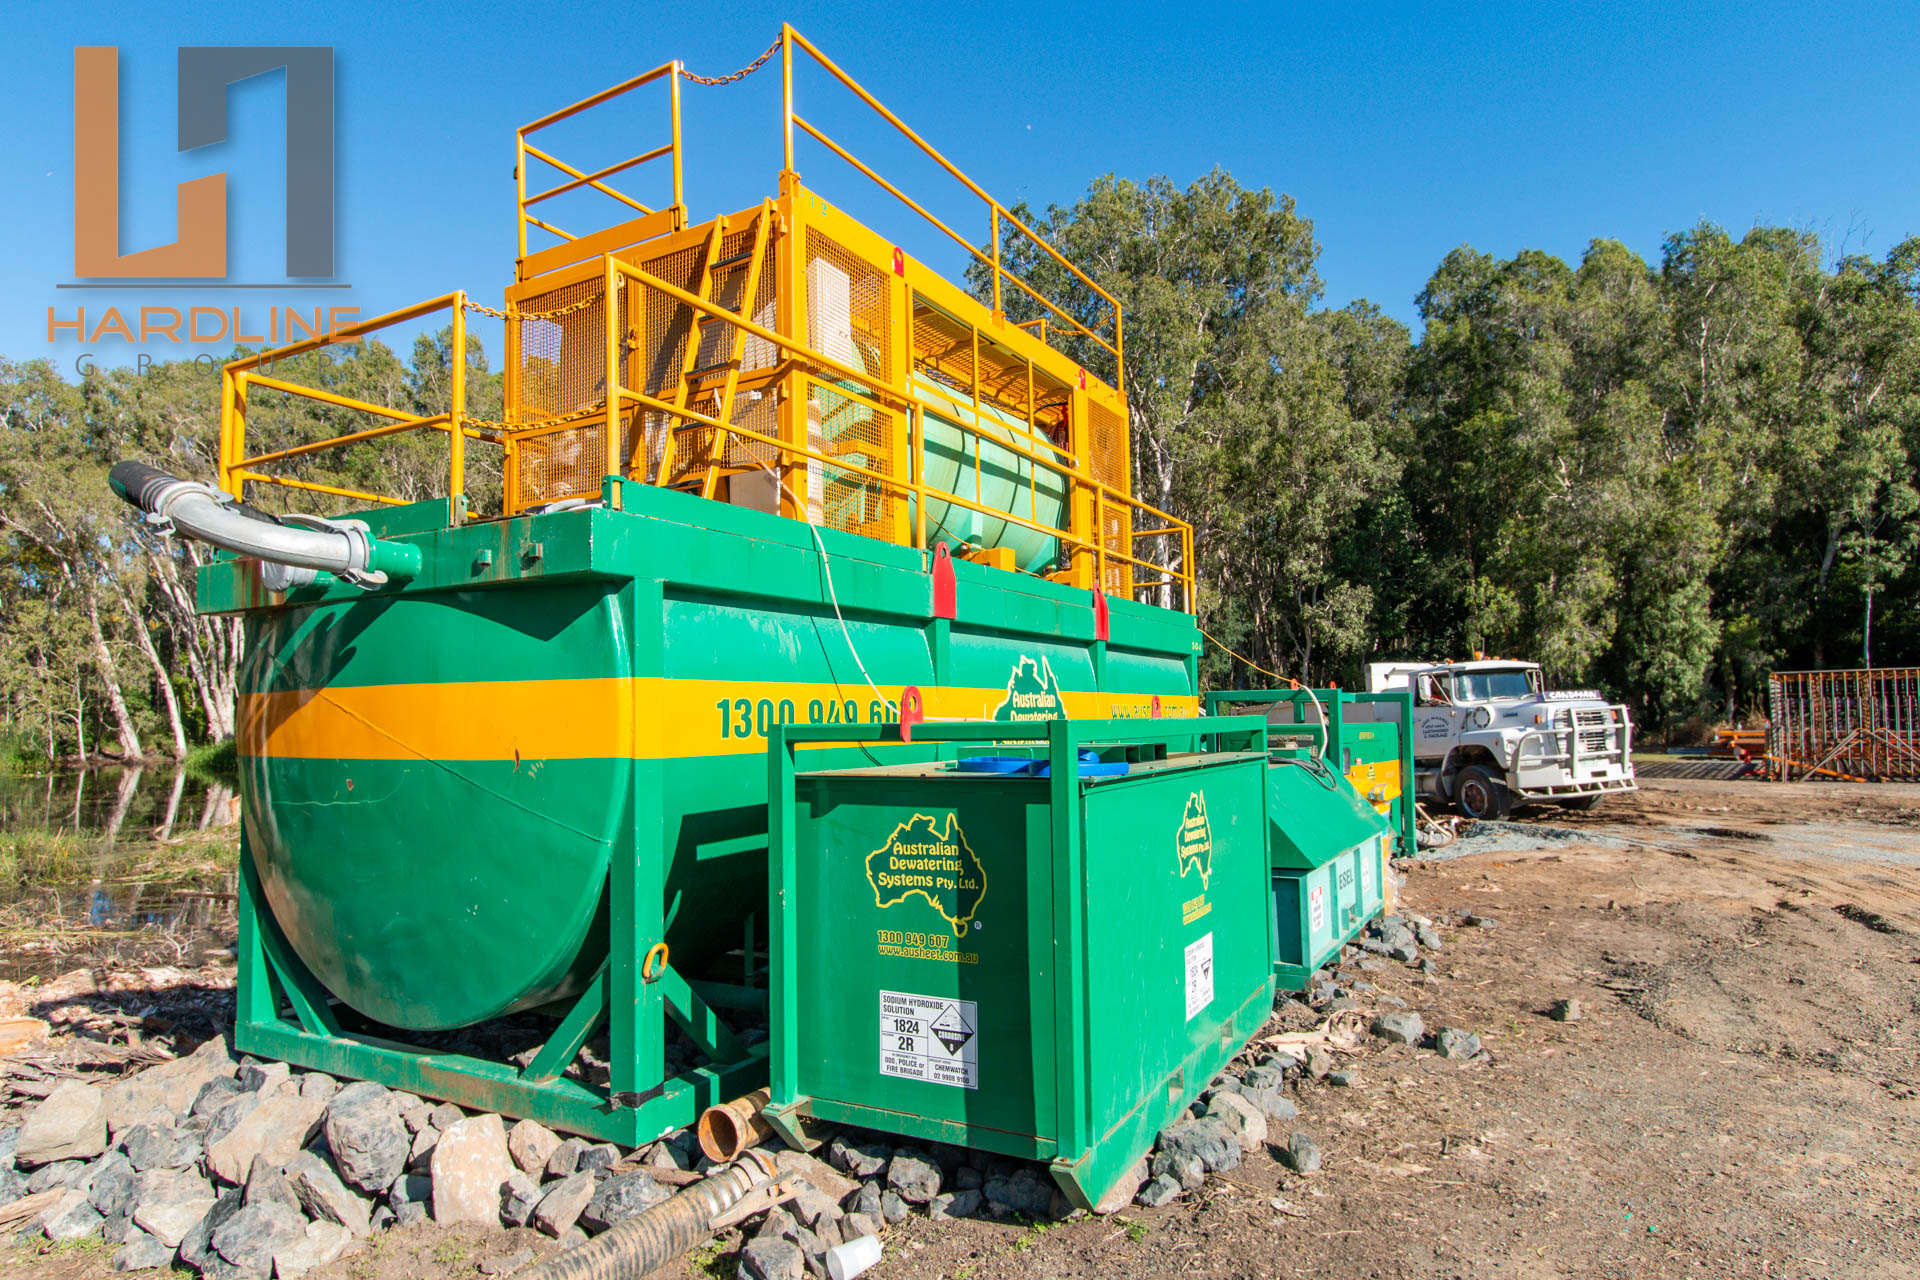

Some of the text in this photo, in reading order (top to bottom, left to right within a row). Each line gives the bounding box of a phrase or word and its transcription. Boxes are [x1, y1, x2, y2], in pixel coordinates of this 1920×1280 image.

[1012, 690, 1056, 708] Australian
[716, 698, 795, 740] 1300
[869, 700, 911, 724] 60
[893, 841, 960, 856] Australian
[889, 856, 965, 876] Dewatering
[878, 872, 979, 890] Systems Pty. Ltd.
[877, 930, 949, 948] 1300 949 607
[878, 944, 979, 964] www.ausheet.com.au
[883, 994, 944, 1010] SODIUM HYDROXIDE
[883, 1004, 915, 1016] SOLUTION
[893, 1018, 920, 1034] 1824
[898, 1036, 914, 1052] 2R
[886, 1064, 924, 1077] FIRE BRIGADE
[898, 1058, 918, 1068] POLICE
[934, 1064, 969, 1075] CHEMWATCH
